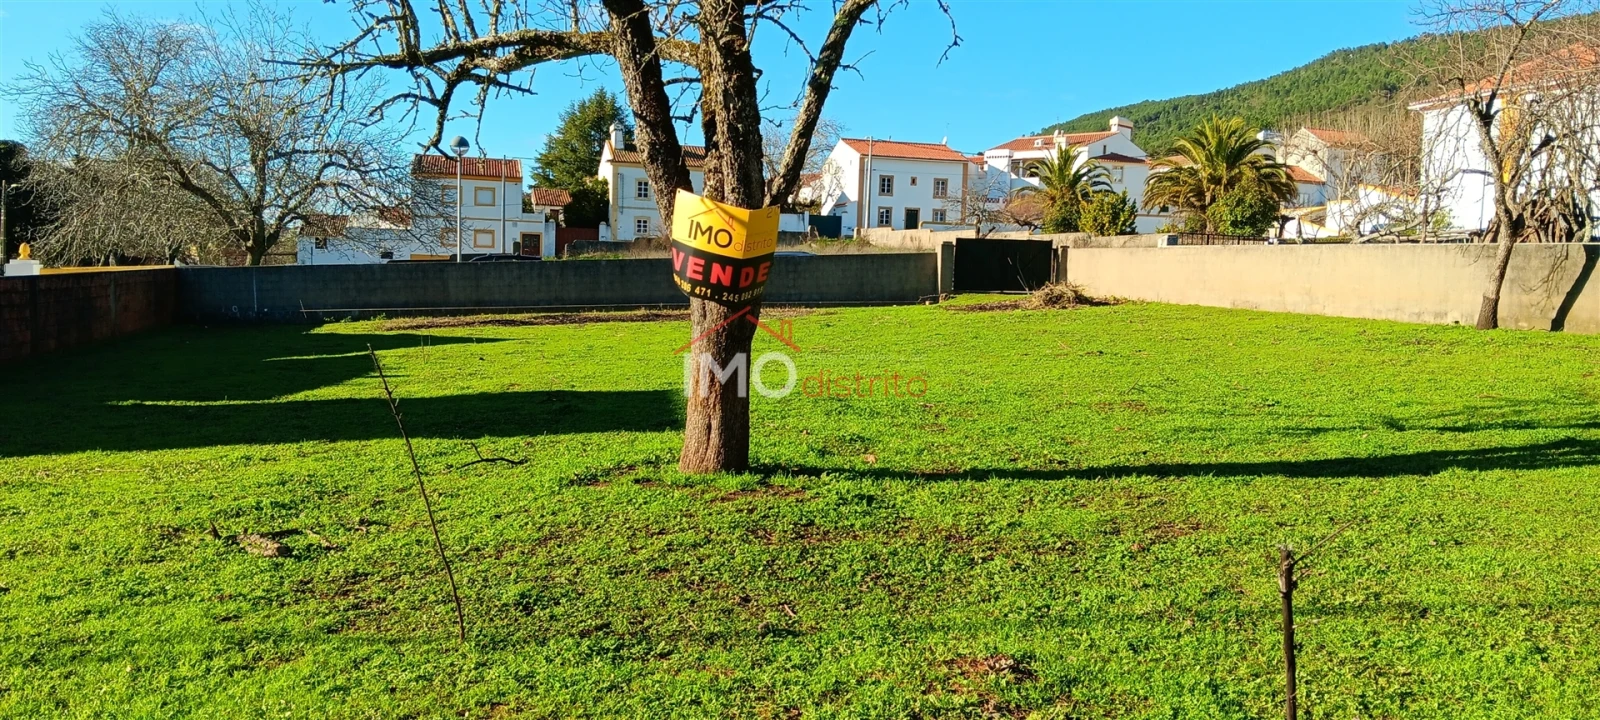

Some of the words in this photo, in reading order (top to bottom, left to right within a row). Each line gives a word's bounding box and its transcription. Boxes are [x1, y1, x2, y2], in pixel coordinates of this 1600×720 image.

[688, 219, 733, 248] IMO
[733, 236, 773, 253] distrito
[671, 247, 771, 289] VENDE
[694, 285, 711, 298] 471
[722, 291, 739, 303] 245
